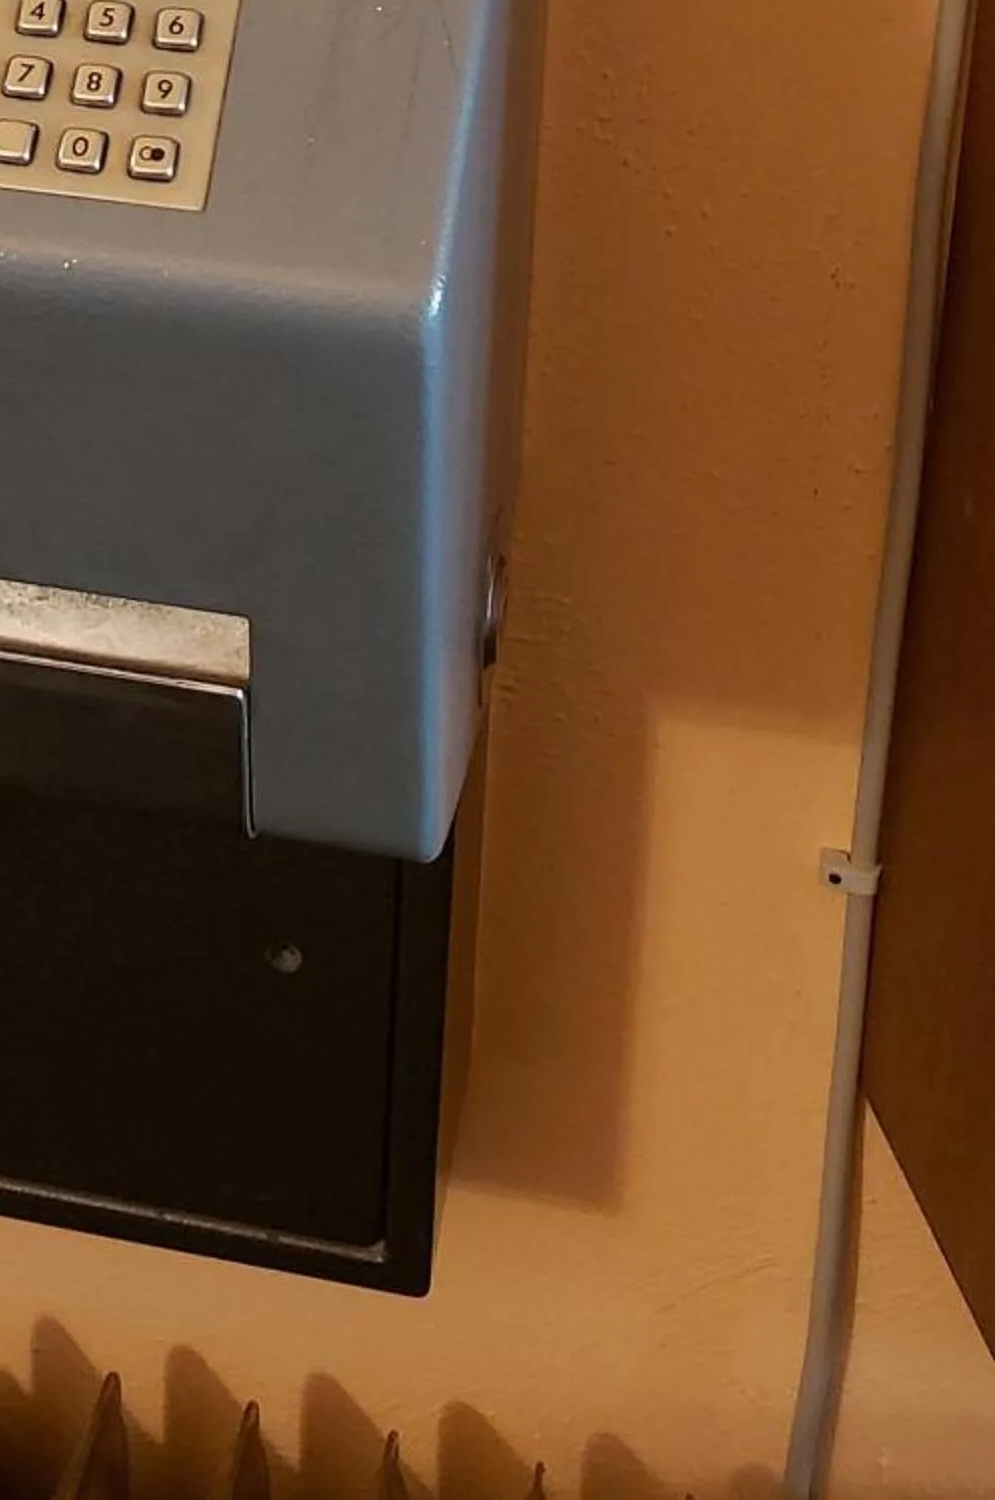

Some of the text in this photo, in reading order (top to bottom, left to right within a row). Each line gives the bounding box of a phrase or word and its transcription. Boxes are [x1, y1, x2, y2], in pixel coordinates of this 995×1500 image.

[30, 0, 185, 36] 4 5 6
[16, 62, 174, 100] 7 8 9
[72, 135, 90, 158] 0
